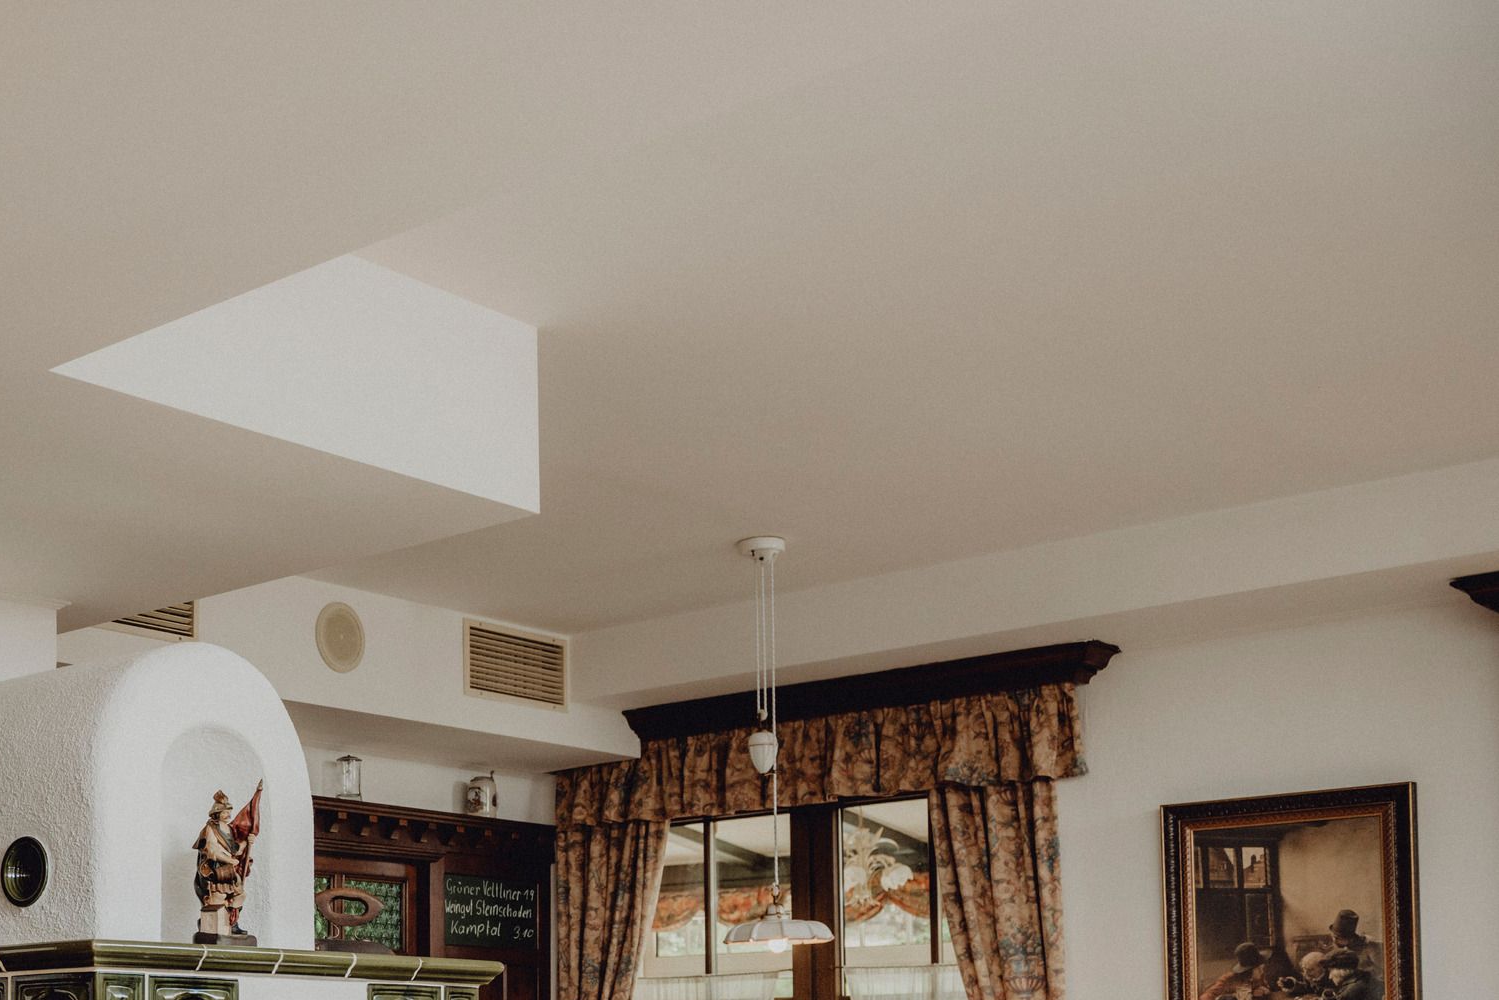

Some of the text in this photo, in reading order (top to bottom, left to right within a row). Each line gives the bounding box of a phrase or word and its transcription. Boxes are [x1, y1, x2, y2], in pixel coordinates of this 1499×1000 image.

[446, 878, 481, 896] Grüner
[523, 889, 535, 902] 19
[445, 899, 473, 919] Weingut
[451, 920, 501, 937] Kamptal
